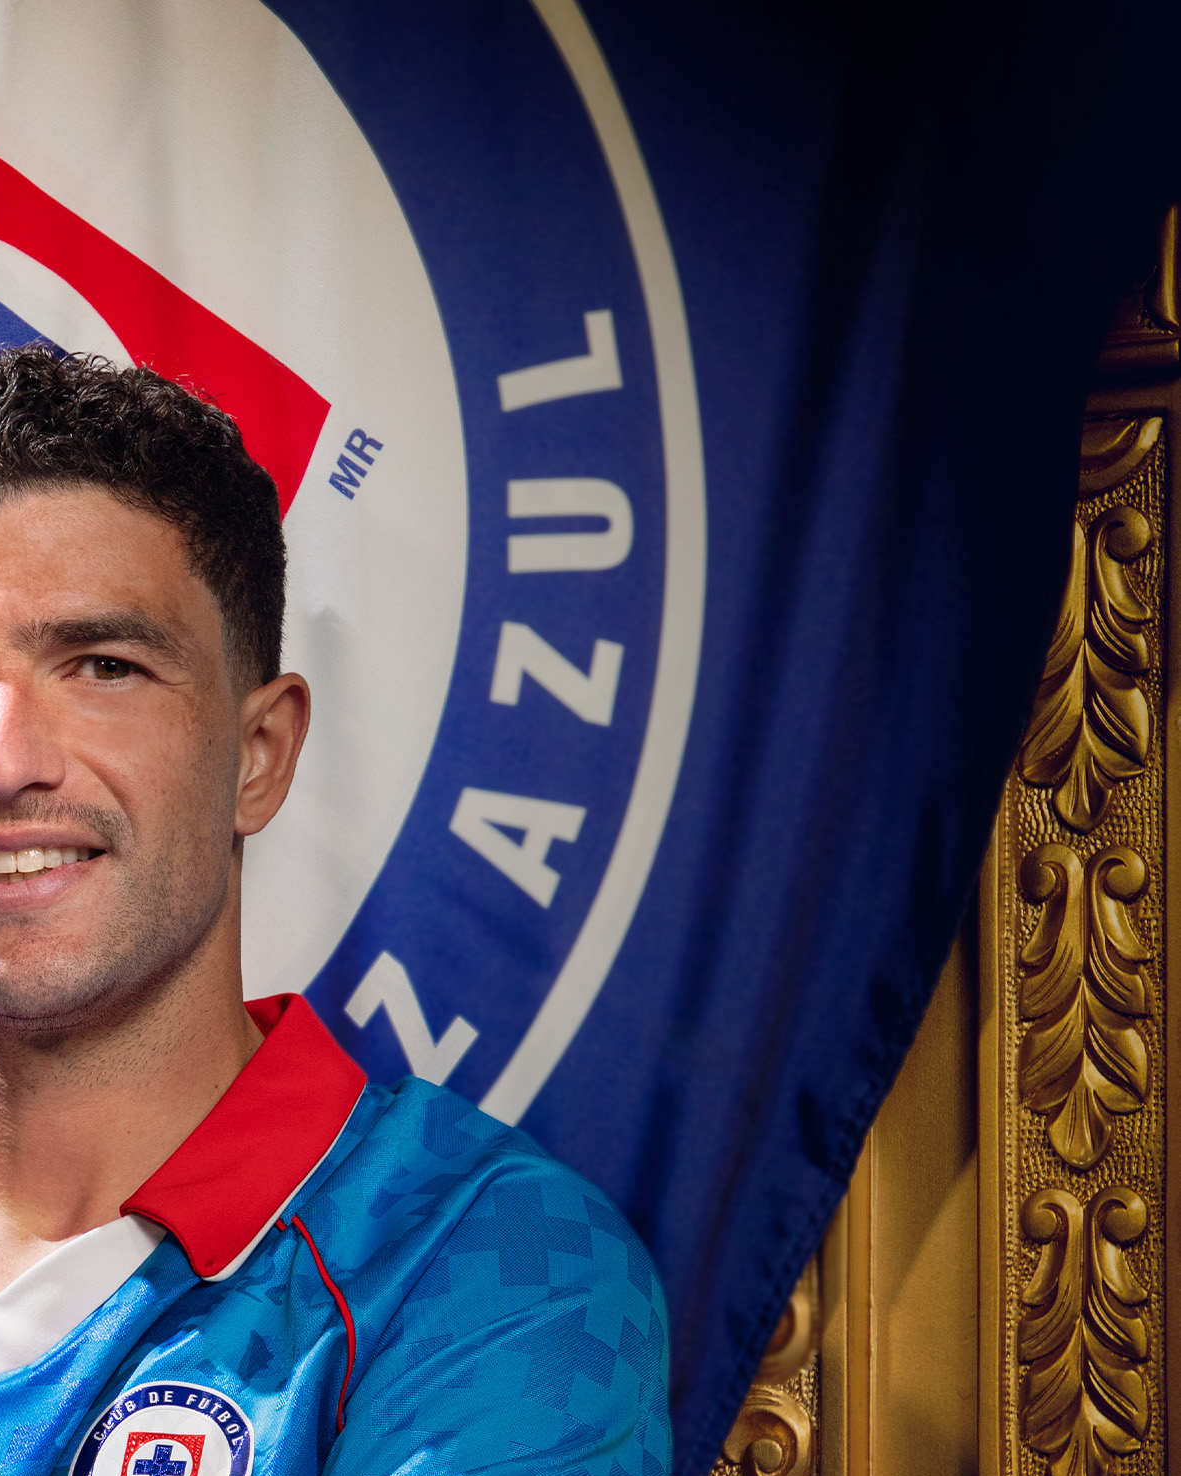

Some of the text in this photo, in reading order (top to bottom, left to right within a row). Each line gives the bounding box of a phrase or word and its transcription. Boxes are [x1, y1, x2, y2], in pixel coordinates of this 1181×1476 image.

[328, 427, 384, 500] MR
[449, 310, 635, 908] AZUL
[93, 1391, 244, 1446] CLUB DE FUTBOL
